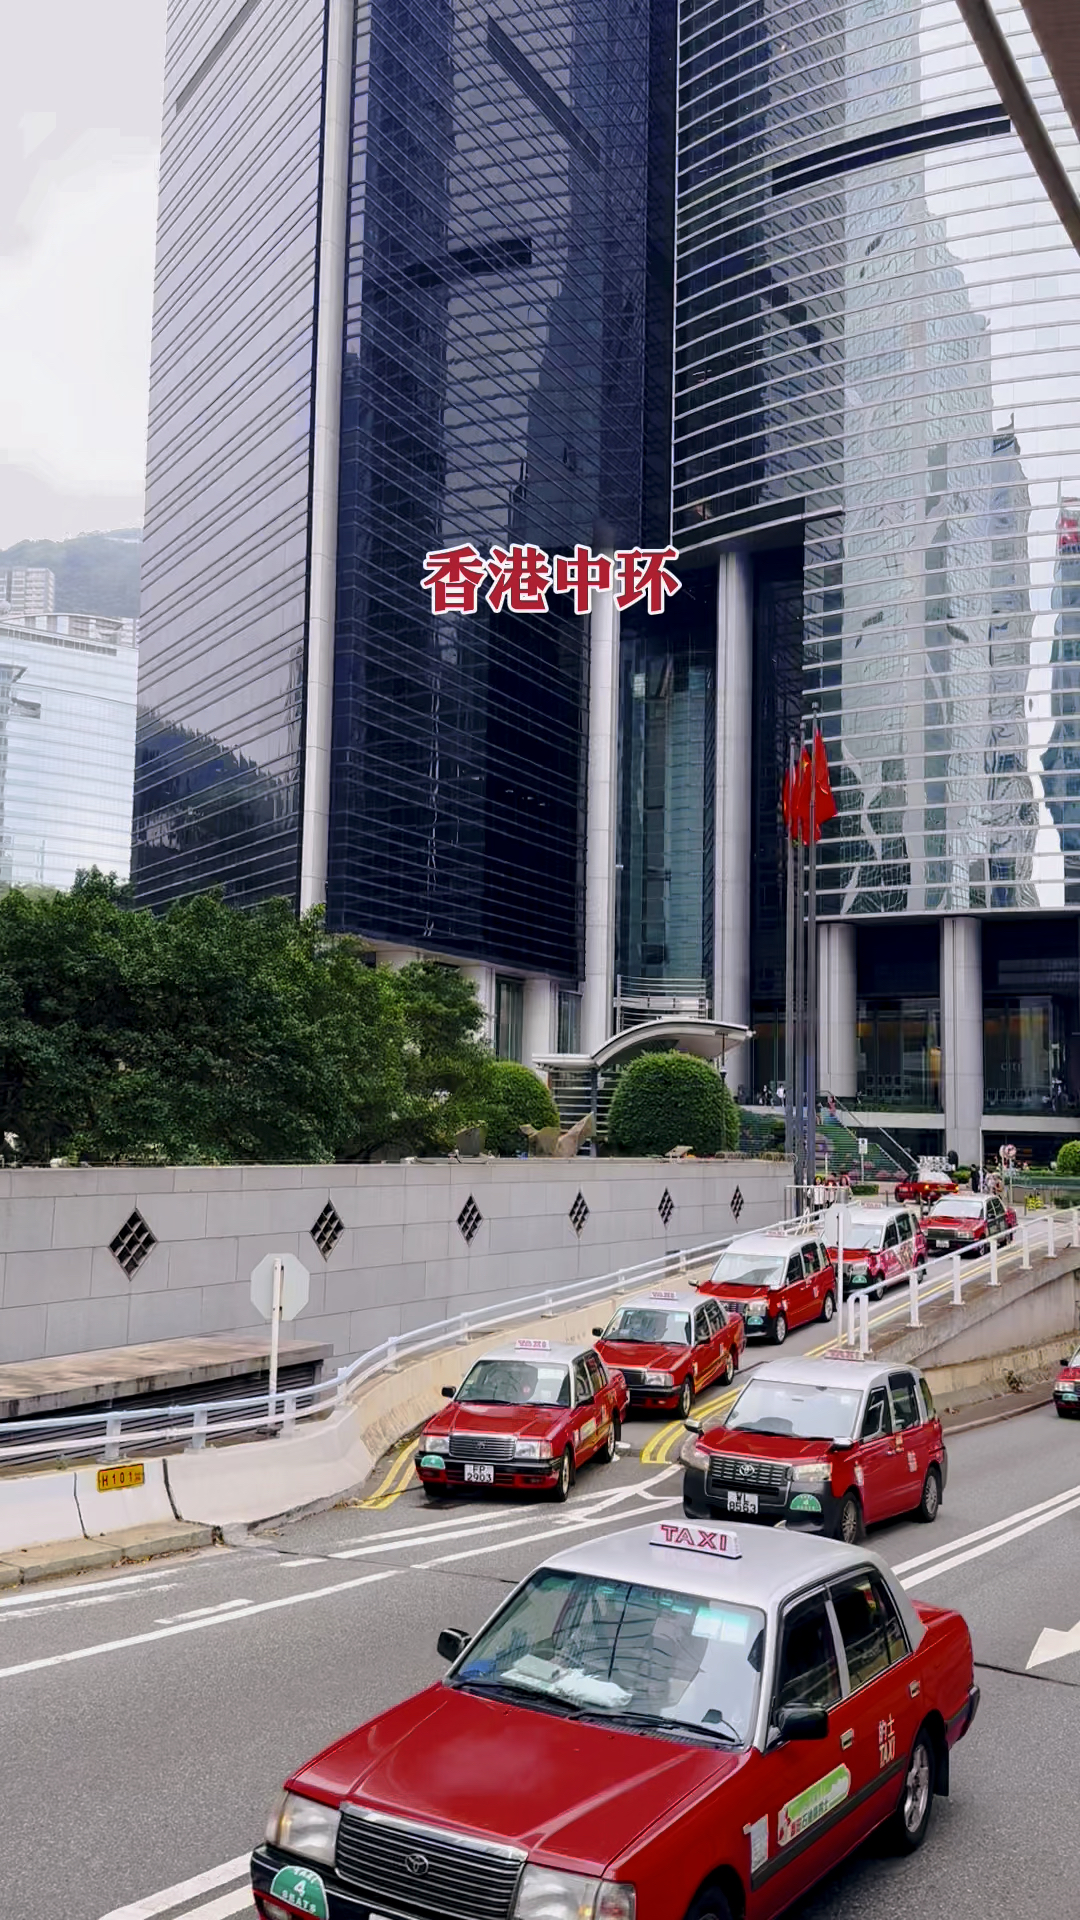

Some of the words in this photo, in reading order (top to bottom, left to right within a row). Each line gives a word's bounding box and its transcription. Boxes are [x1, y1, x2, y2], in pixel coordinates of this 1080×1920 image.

[467, 1472, 491, 1482] 2903
[473, 1464, 486, 1473] FP
[736, 1491, 750, 1503] WL
[661, 1524, 727, 1551] TAXI
[878, 1712, 895, 1745] 的士
[879, 1735, 896, 1769] TAXI
[294, 1880, 307, 1897] 4
[281, 1889, 317, 1913] SEATS
